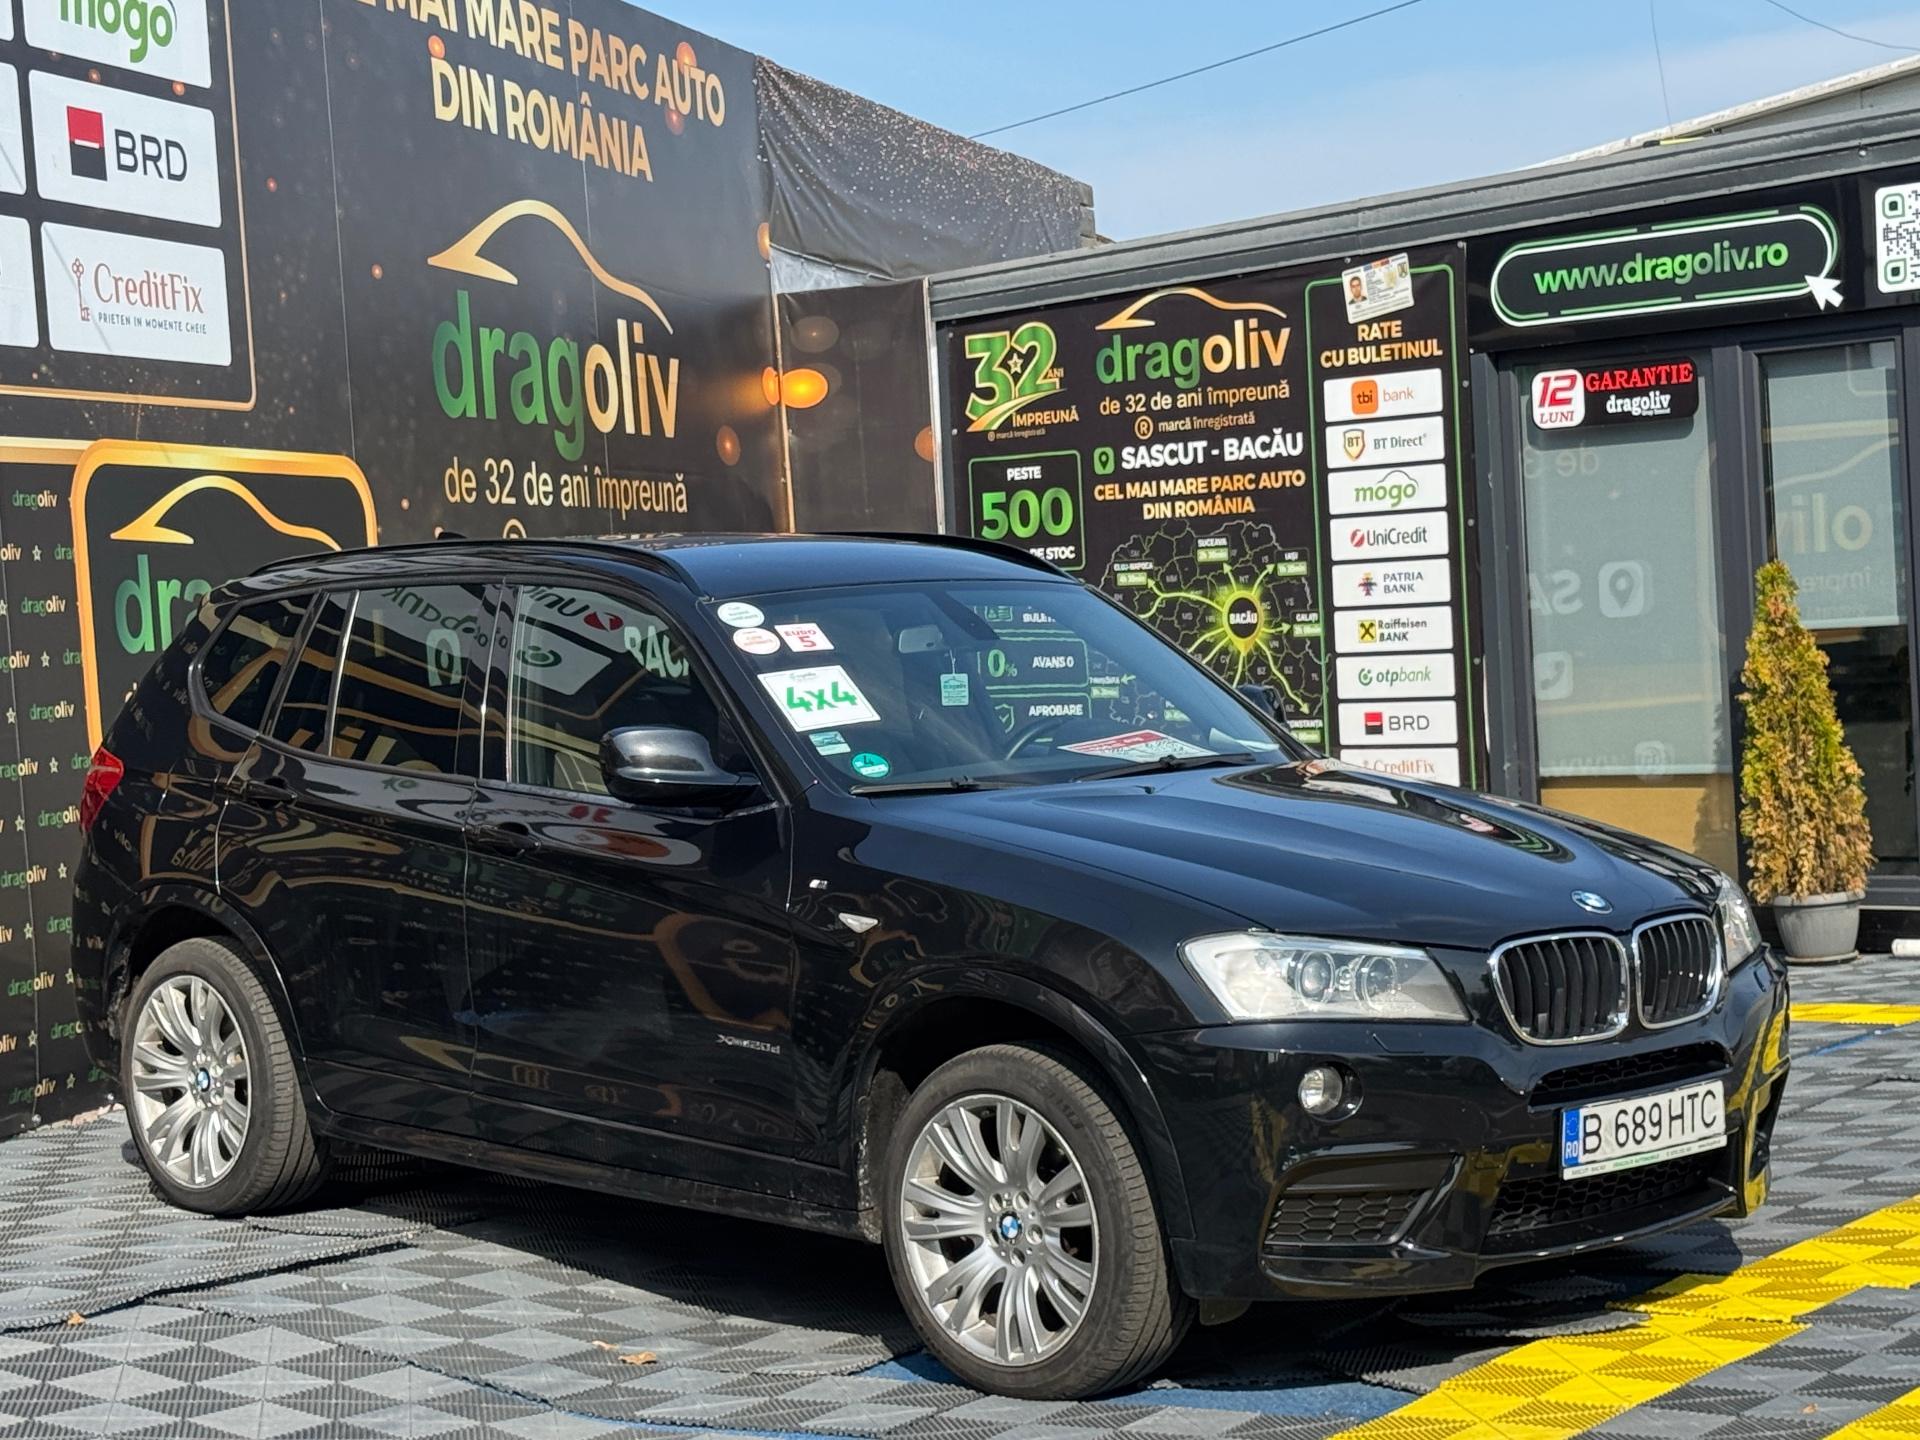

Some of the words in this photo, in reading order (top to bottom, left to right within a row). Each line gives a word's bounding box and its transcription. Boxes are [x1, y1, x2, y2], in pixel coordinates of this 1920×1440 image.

[465, 0, 564, 71] MARE
[568, 18, 650, 100] PARC
[654, 53, 726, 127] AUTO
[430, 57, 499, 135] DIN
[502, 79, 654, 182] ROMÂNIA
[114, 129, 188, 182] BRD
[1533, 240, 1790, 296] www.dragoliv.ro
[94, 262, 205, 314] CreditFix
[98, 311, 131, 326] PRIETEN
[133, 316, 143, 328] IN
[145, 318, 183, 332] MOMENTE
[185, 322, 207, 335] CHEIE
[1357, 320, 1403, 342] RATE
[1096, 318, 1291, 389] dragoliv
[1320, 348, 1344, 368] CU
[1347, 339, 1443, 366] BULETINUL
[432, 289, 680, 462] dragoliv
[964, 321, 1060, 421] 32
[1047, 367, 1064, 378] ANI
[1100, 396, 1121, 416] de
[1125, 393, 1147, 413] 32
[1151, 391, 1173, 411] de
[1177, 388, 1203, 409] ani
[1207, 378, 1290, 408] împreună
[1356, 388, 1374, 405] tbi
[1383, 387, 1415, 402] bank
[1538, 374, 1578, 409] 12
[1585, 362, 1694, 393] GARANTIE
[1606, 390, 1671, 416] dragoliv
[1012, 405, 1080, 428] ÎMPREUNĂ
[1158, 416, 1192, 433] marcă
[1193, 411, 1256, 431] înregistrată
[1540, 410, 1575, 425] LUNI
[1121, 439, 1208, 470] SASCUT
[1223, 427, 1304, 463] BACĂU
[1347, 435, 1361, 449] BT
[1374, 437, 1388, 450] BT
[1006, 465, 1042, 481] PESTE
[444, 456, 477, 504] de
[484, 457, 517, 505] 32
[523, 461, 554, 507] de
[560, 465, 591, 509] ani
[594, 467, 689, 521] împreună
[1094, 482, 1128, 502] CEL
[1129, 479, 1158, 500] MAI
[1160, 475, 1208, 497] MARE
[1210, 472, 1256, 493] PARC
[1258, 469, 1306, 490] AUTO
[1354, 482, 1417, 508] mogo
[12, 489, 58, 511] dragoliv
[1143, 501, 1174, 520] DIN
[1174, 494, 1256, 519] ROMÂNIA
[981, 487, 1074, 540] 500
[1366, 526, 1428, 546] UniCredit
[1046, 545, 1076, 561] STOC
[1383, 571, 1424, 582] PATRIA
[1383, 583, 1416, 595] BANK
[21, 595, 66, 617] dragoliv
[1229, 610, 1258, 625] BACĂU
[783, 629, 817, 637] EURO
[1377, 617, 1428, 630] Raiffeisen
[799, 636, 817, 648] 5
[1379, 630, 1410, 642] BANK
[1032, 655, 1065, 669] AVANS
[1376, 666, 1432, 687] otpbank
[30, 700, 75, 723] dragoliv
[1028, 703, 1084, 717] APROBARE
[1388, 715, 1431, 731] BRD
[1, 864, 48, 889] dragoliv
[8, 971, 56, 997] dragoliv
[9, 1078, 57, 1104] dragoliv
[1582, 1113, 1602, 1156] B
[1565, 1141, 1579, 1160] RO
